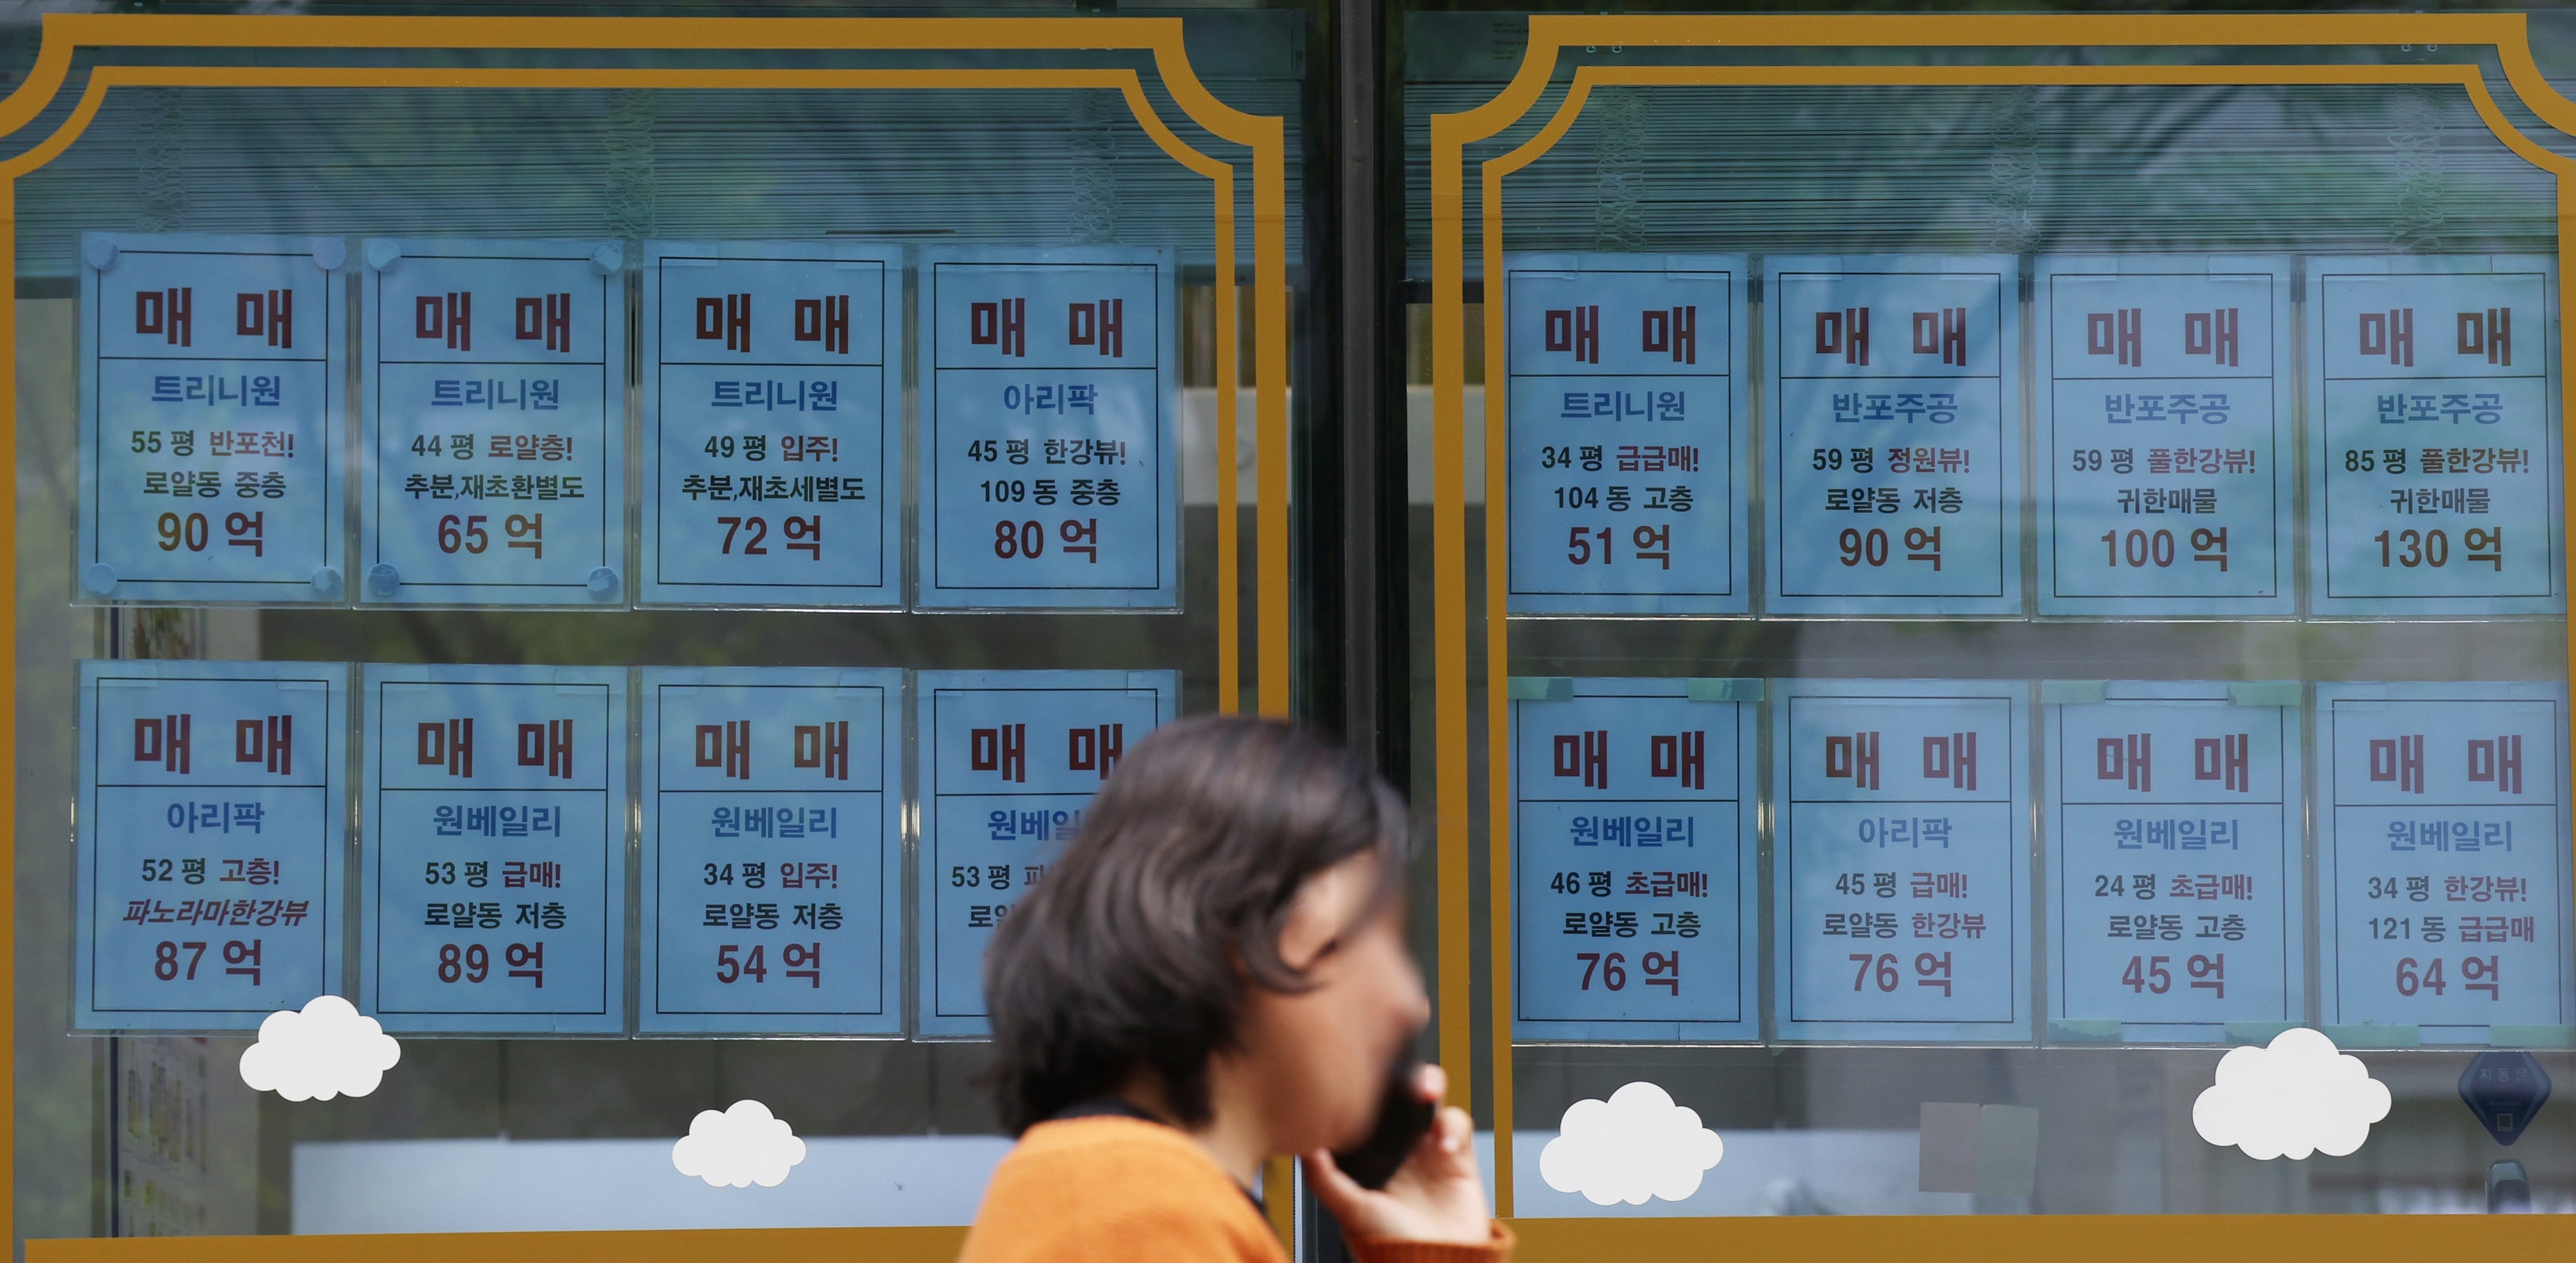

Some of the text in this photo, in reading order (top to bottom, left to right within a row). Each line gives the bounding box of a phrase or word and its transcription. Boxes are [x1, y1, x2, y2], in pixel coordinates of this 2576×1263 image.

[136, 287, 293, 349] 매 매
[415, 291, 571, 354] 매 매
[696, 293, 850, 355] 매 매
[971, 297, 1123, 358] 매 매
[1545, 305, 1696, 365] 매 매
[1815, 306, 1966, 367] 매 매
[2087, 307, 2239, 367] 매 매
[2359, 307, 2512, 367] 매 매
[151, 374, 280, 407] 트리니원
[431, 379, 559, 411] 트리니원
[711, 379, 838, 412] 트리니원
[1003, 383, 1098, 415] 아리팍
[1560, 390, 1685, 422] 트리니원
[1833, 392, 1957, 424] 반포주공
[2105, 393, 2231, 425] 반포주공
[2377, 393, 2504, 424] 반포주공
[130, 429, 295, 459] 55 평 반포천!
[411, 434, 573, 461] 44 평 로얄층!
[704, 434, 838, 463] 49 평 입주!
[967, 438, 1126, 466] 45 평 한강뷰!
[1541, 445, 1699, 472] 34 평 급급매!
[1812, 447, 1969, 474] 59 평 정원뷰!
[2072, 447, 2256, 475] 59 평 풀한강뷰!
[2345, 447, 2529, 475] 85 평 풀한강뷰!
[143, 470, 287, 499] 로얄동 중층
[404, 473, 585, 501] 추분,재초환별도
[682, 474, 866, 502] 추분,재초세별도
[980, 478, 1121, 506] 109 동 중층
[1554, 485, 1694, 513] 104 동 고층
[1824, 486, 1964, 514] 로얄동 저층
[2117, 488, 2218, 515] 귀한매물
[2390, 487, 2491, 515] 귀한매물
[157, 511, 264, 557] 90 억
[437, 513, 543, 559] 65 억
[717, 515, 821, 562] 72 억
[994, 518, 1097, 564] 80 억
[1568, 524, 1670, 571] 51 억
[1838, 526, 1941, 572] 90 억
[2101, 526, 2228, 573] 100 억
[2374, 526, 2502, 572] 130 억
[134, 713, 293, 776] 매 매
[418, 717, 573, 779] 매 매
[695, 720, 849, 781] 매 매
[971, 723, 1026, 783] 매
[1553, 730, 1706, 791] 매 매
[1825, 731, 1977, 791] 매 매
[2097, 733, 2249, 793] 매 매
[2369, 734, 2522, 795] 매 매
[167, 801, 265, 834] 아리팍
[433, 804, 561, 838] 원베일리
[710, 806, 837, 839] 원베일리
[988, 809, 1083, 841] 원베일
[1570, 816, 1694, 848] 원베일리
[1858, 816, 1953, 849] 아리팍
[2113, 818, 2239, 851] 원베일리
[2387, 820, 2512, 852] 원베일리
[141, 857, 280, 886] 52 평 고층!
[424, 860, 561, 889] 53 평 급매!
[703, 861, 838, 889] 34 평 입주!
[951, 866, 980, 888] 53
[987, 864, 1010, 891] 평
[1550, 871, 1708, 898] 46 평 초급매!
[1835, 871, 1968, 899] 45 평 급매!
[2094, 873, 2252, 901] 24 평 초급매!
[2368, 875, 2527, 903] 34 평 한강뷰!
[122, 898, 310, 927] 파노라마한강뷰
[424, 902, 567, 930] 로얄동 저층
[702, 902, 843, 930] 로얄동 저층
[1562, 911, 1701, 939] 로얄동 고층
[1822, 912, 1987, 939] 로얄동 한강뷰
[2107, 914, 2247, 942] 로얄동 고층
[2368, 916, 2535, 943] 121 동 급급매
[154, 939, 262, 986] 87 억
[438, 942, 544, 989] 89 억
[716, 942, 821, 989] 54 억
[1576, 951, 1679, 996] 76 억
[1849, 951, 1952, 998] 76 억
[2122, 953, 2225, 999] 45 억
[2396, 955, 2499, 1001] 64 억
